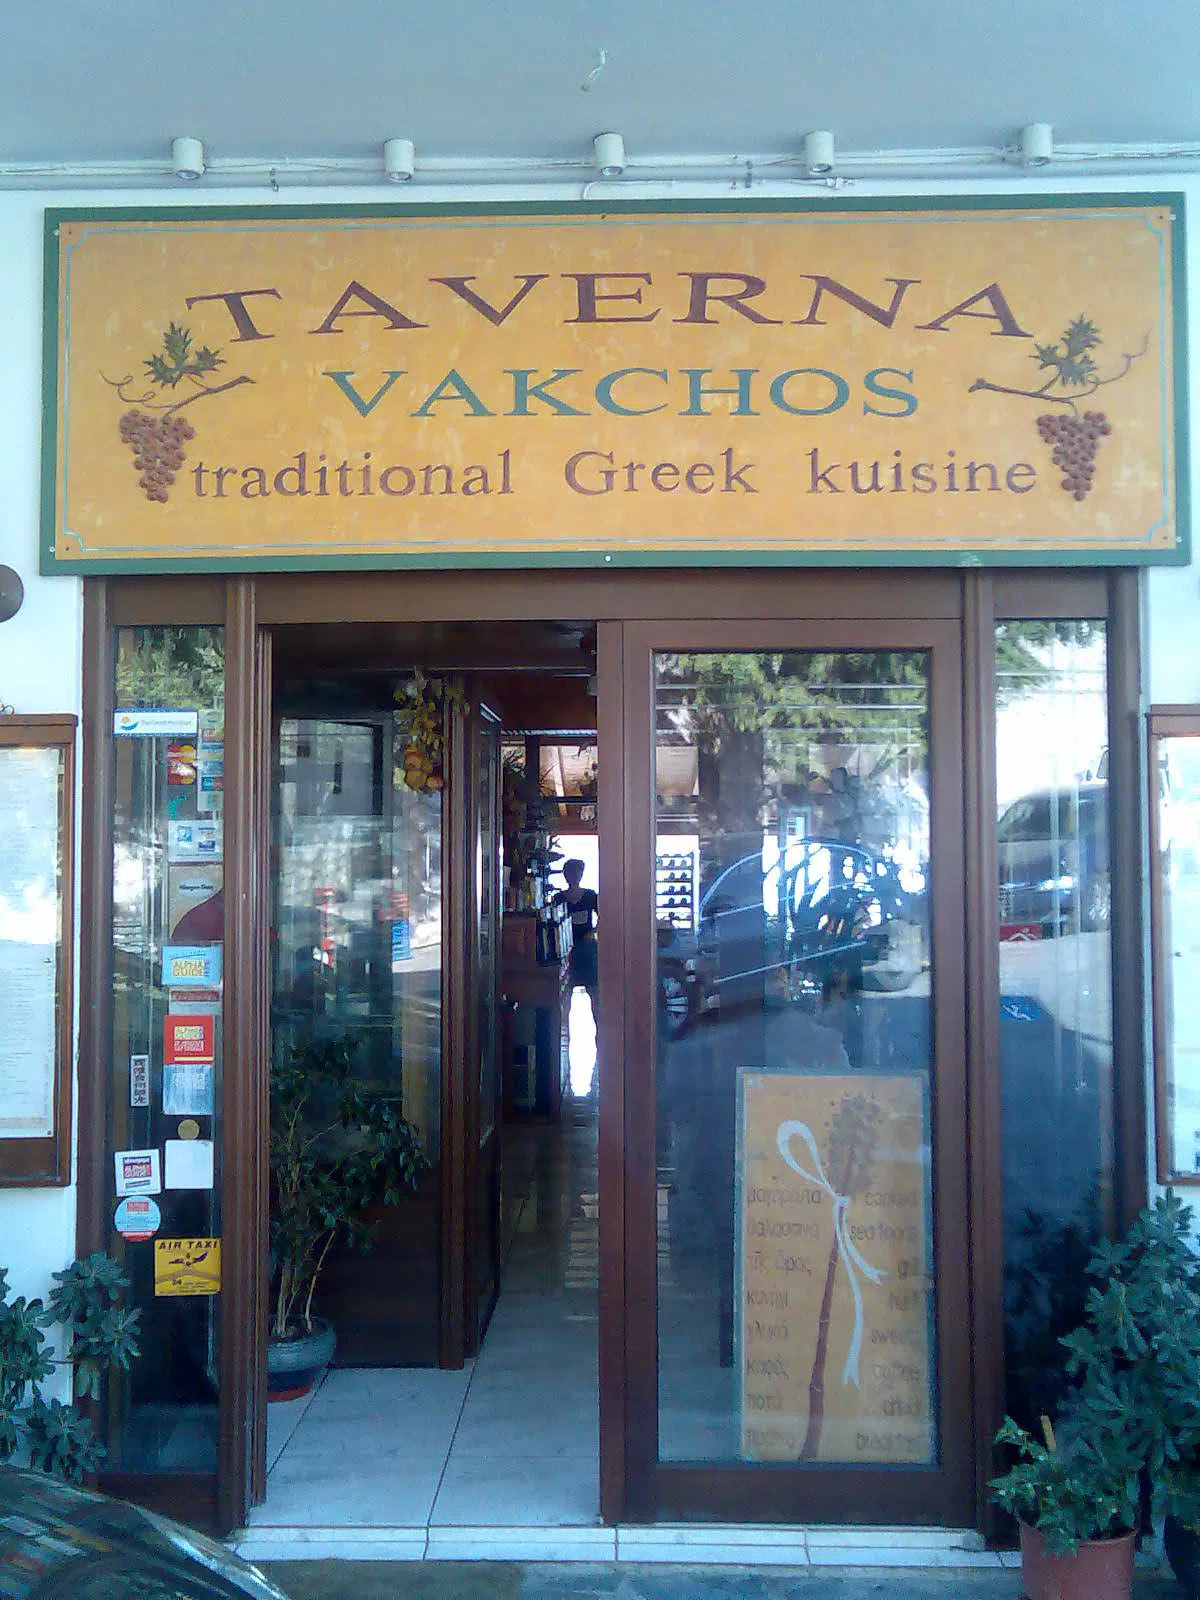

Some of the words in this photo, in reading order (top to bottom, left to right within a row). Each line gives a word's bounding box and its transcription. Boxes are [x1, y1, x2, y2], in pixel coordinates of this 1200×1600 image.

[185, 272, 1034, 343] TAVERNA
[322, 367, 919, 418] VAKCHOS
[191, 449, 514, 499] traditional
[565, 448, 759, 497] Greek
[806, 448, 1037, 495] kuisine
[159, 1241, 181, 1250] AIR
[188, 1240, 217, 1249] TAXI
